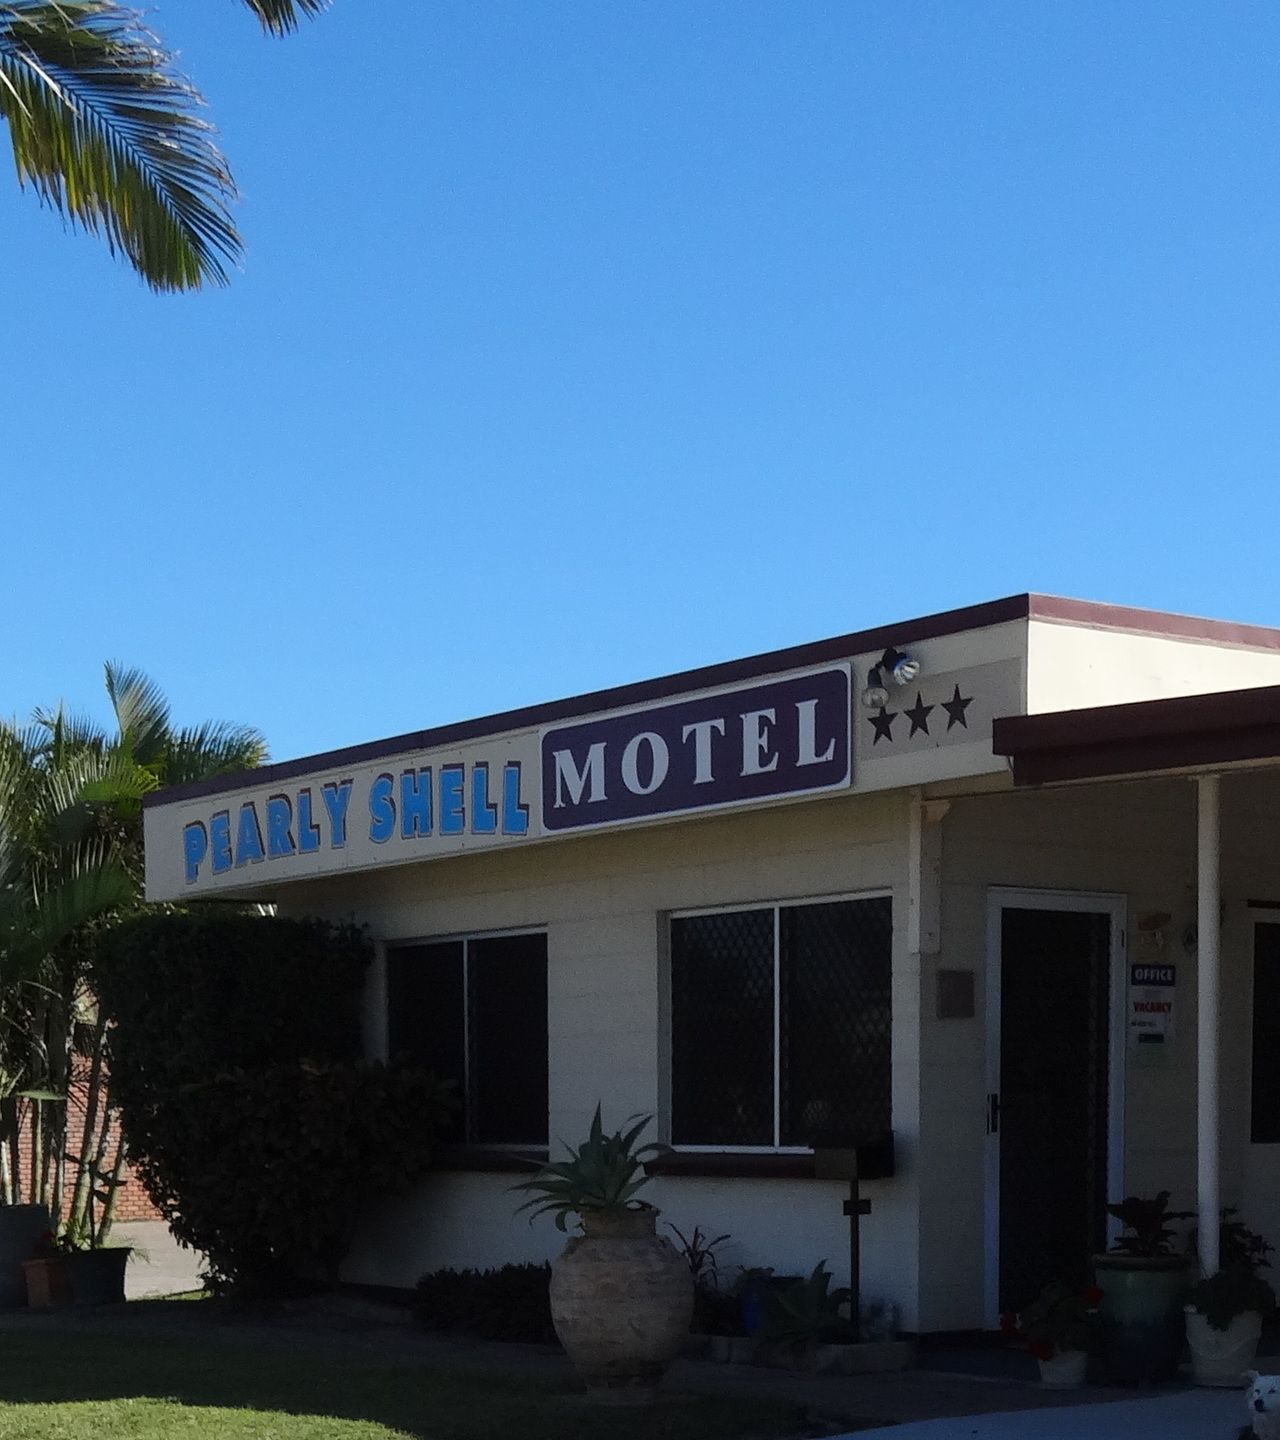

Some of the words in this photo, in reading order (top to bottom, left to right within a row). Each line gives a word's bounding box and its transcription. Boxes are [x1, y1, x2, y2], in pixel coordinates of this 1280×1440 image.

[183, 777, 353, 884] PEARLY
[369, 760, 530, 845] SHELL
[551, 697, 838, 811] MOTEL
[1135, 968, 1172, 982] OFFICE
[1133, 1001, 1171, 1014] VACANCY
